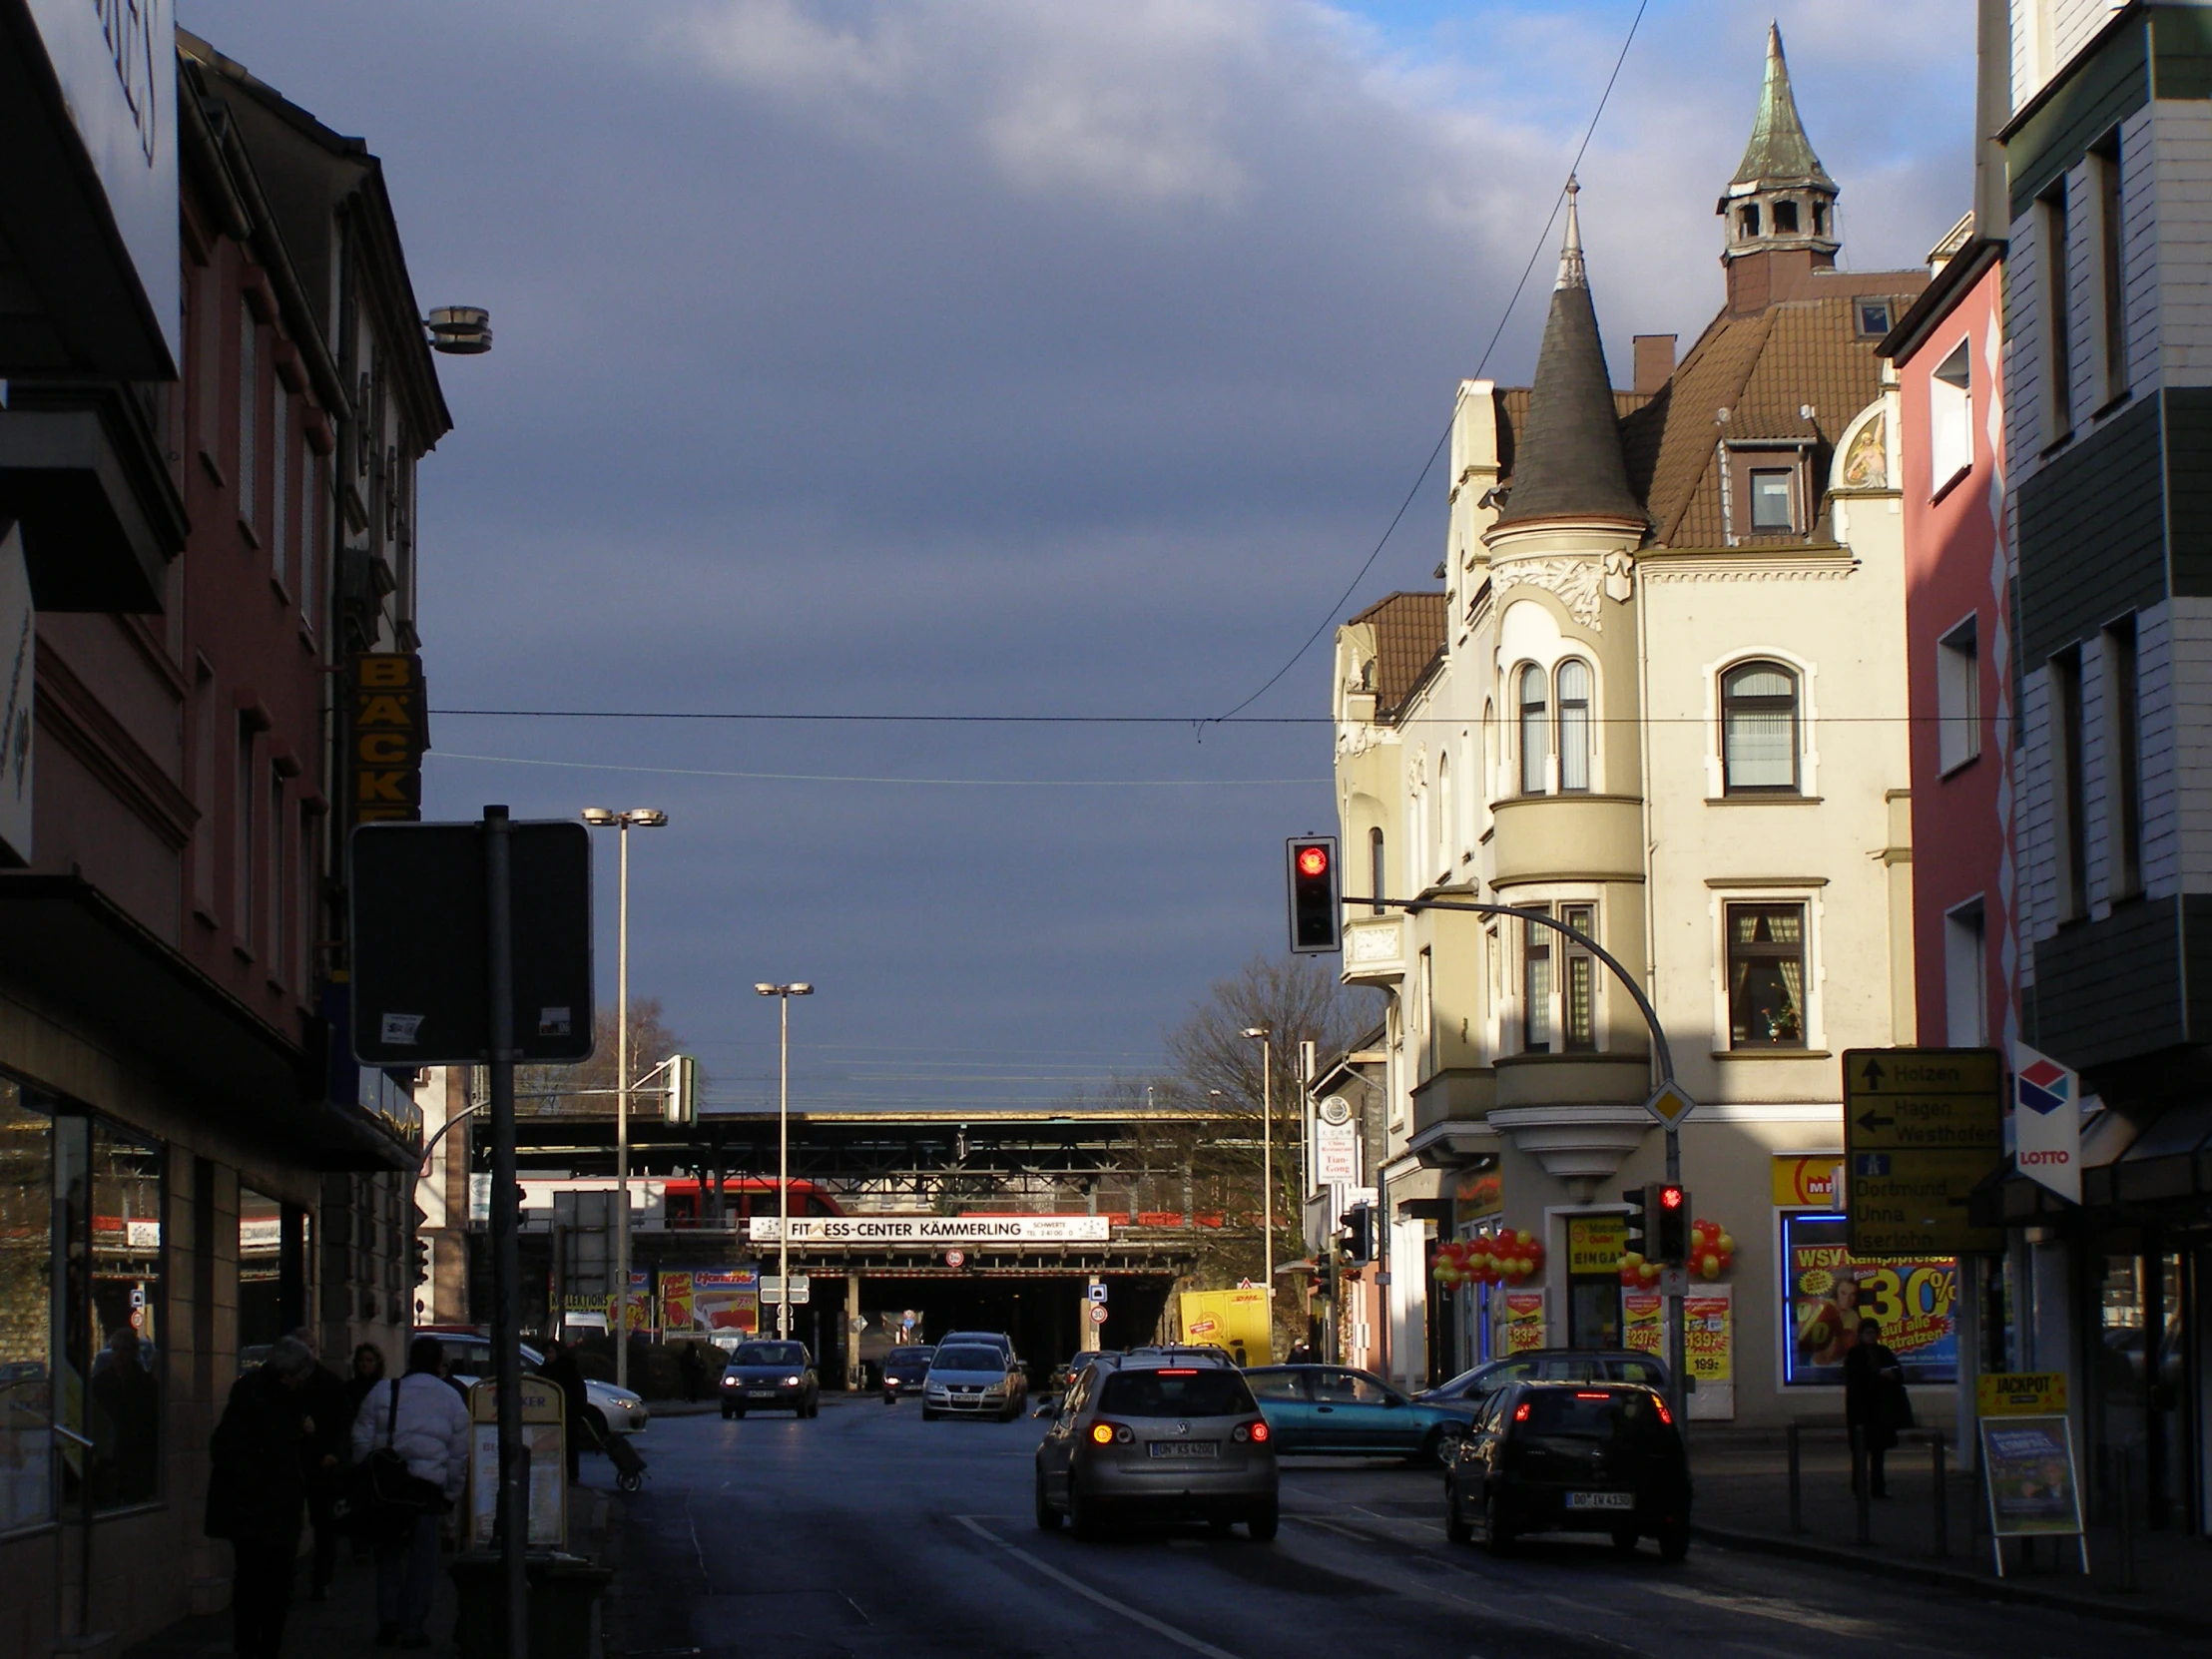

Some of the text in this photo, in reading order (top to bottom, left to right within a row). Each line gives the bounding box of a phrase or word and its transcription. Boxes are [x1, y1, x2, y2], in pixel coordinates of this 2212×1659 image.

[1895, 1065, 1959, 1081] Holzen
[1895, 1101, 1951, 1120] Hagen
[1897, 1125, 1998, 1142] Westhofen
[2020, 1151, 2068, 1165] LOTTO
[1326, 1165, 1350, 1174] Gong
[1809, 1183, 1833, 1193] MF
[1857, 1179, 1946, 1197] Dortmund
[1857, 1206, 1905, 1222] Unna
[920, 1221, 1021, 1236] KÄMMERLING
[1857, 1231, 1933, 1247] Iserlohn
[1574, 1253, 1624, 1265] EINGA
[1797, 1249, 1843, 1268] WSV
[696, 1271, 757, 1287] Hammer
[551, 1295, 608, 1306] KLEKTIONS
[1859, 1267, 1956, 1328] 30%
[1881, 1316, 1931, 1337] auf alle
[1996, 1377, 2049, 1393] JACKPOT
